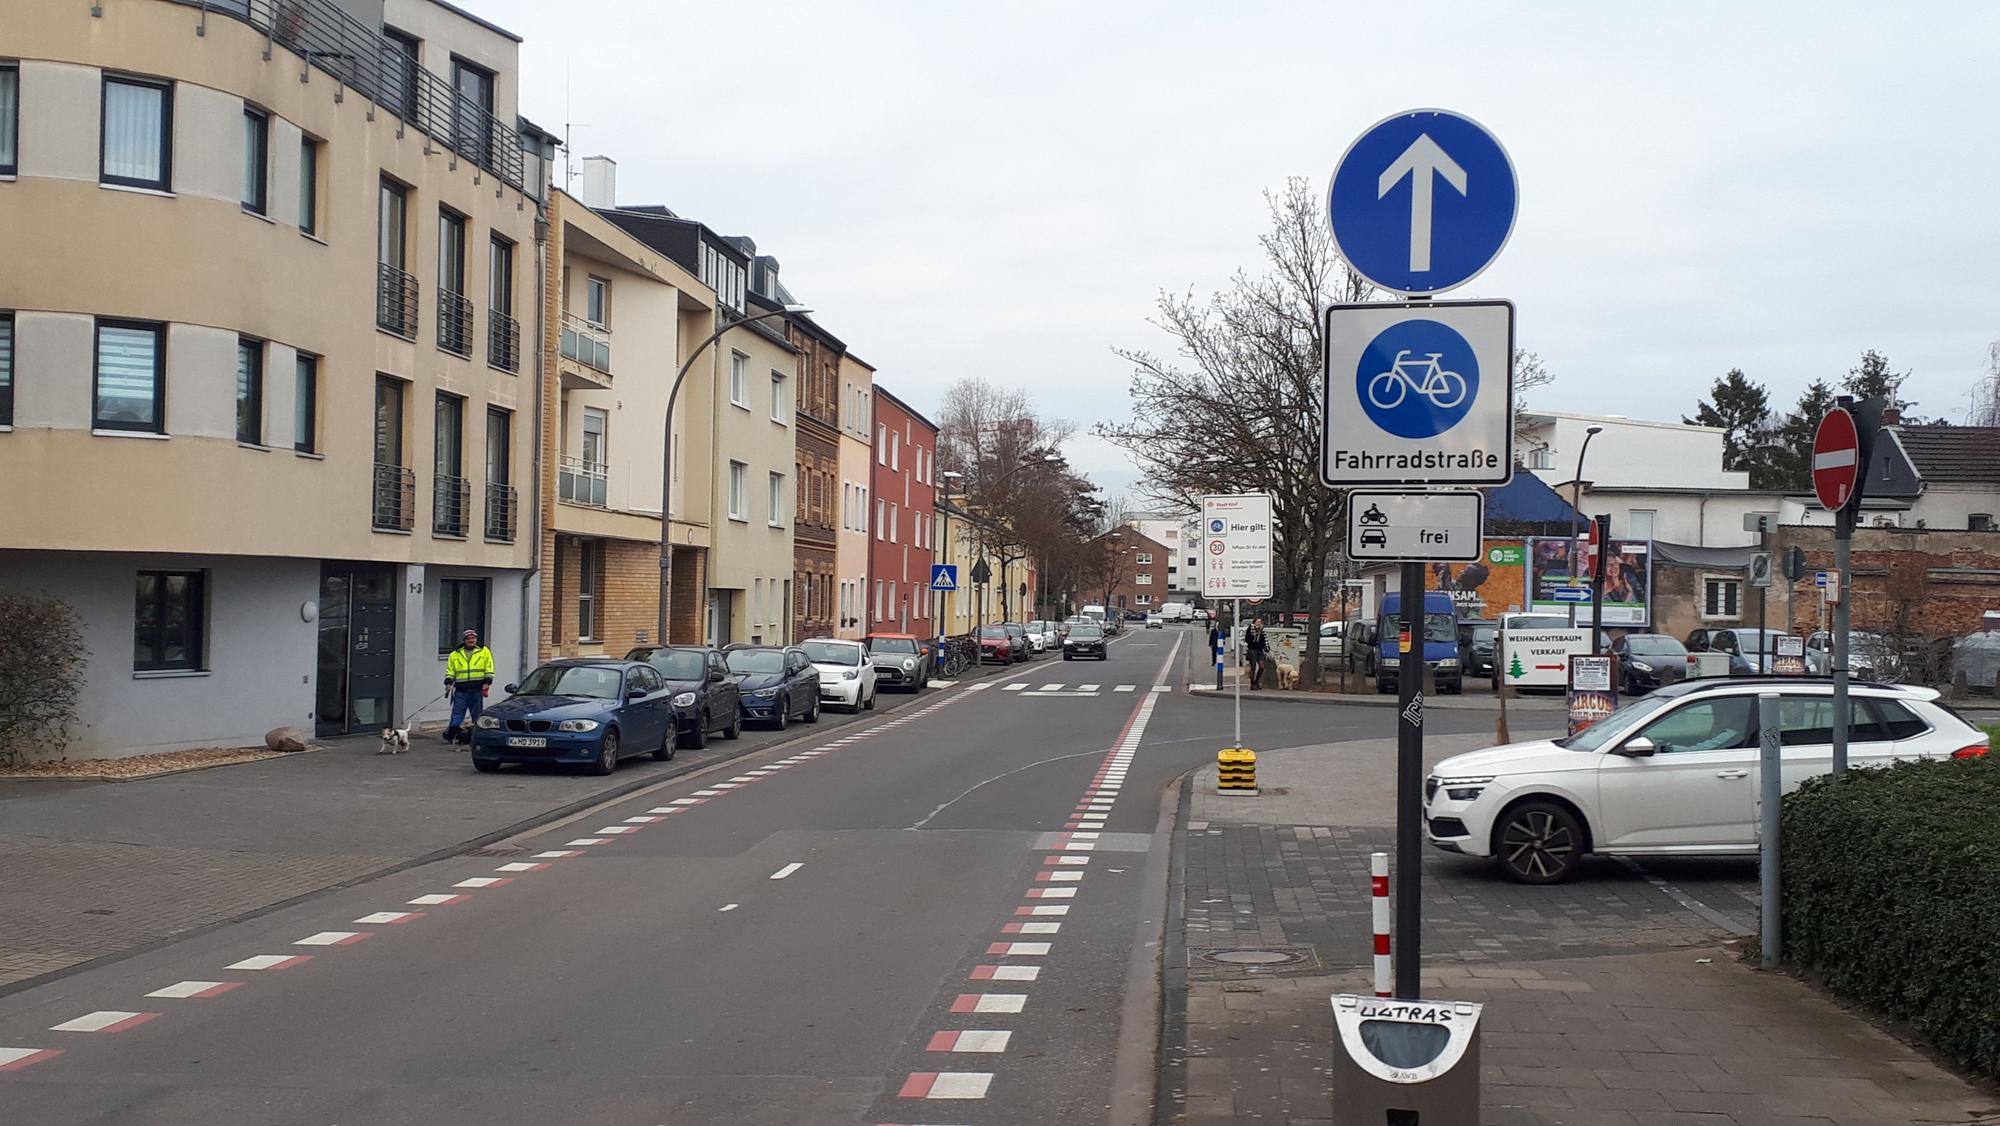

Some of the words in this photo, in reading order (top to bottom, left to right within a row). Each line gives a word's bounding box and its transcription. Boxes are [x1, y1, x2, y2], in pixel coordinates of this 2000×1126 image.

[1335, 450, 1498, 469] Fahrradstraße
[1231, 523, 1248, 531] Hier
[1250, 523, 1266, 532] gilt:
[1419, 530, 1449, 544] frei
[1212, 543, 1222, 552] 30
[409, 583, 423, 594] 1-3
